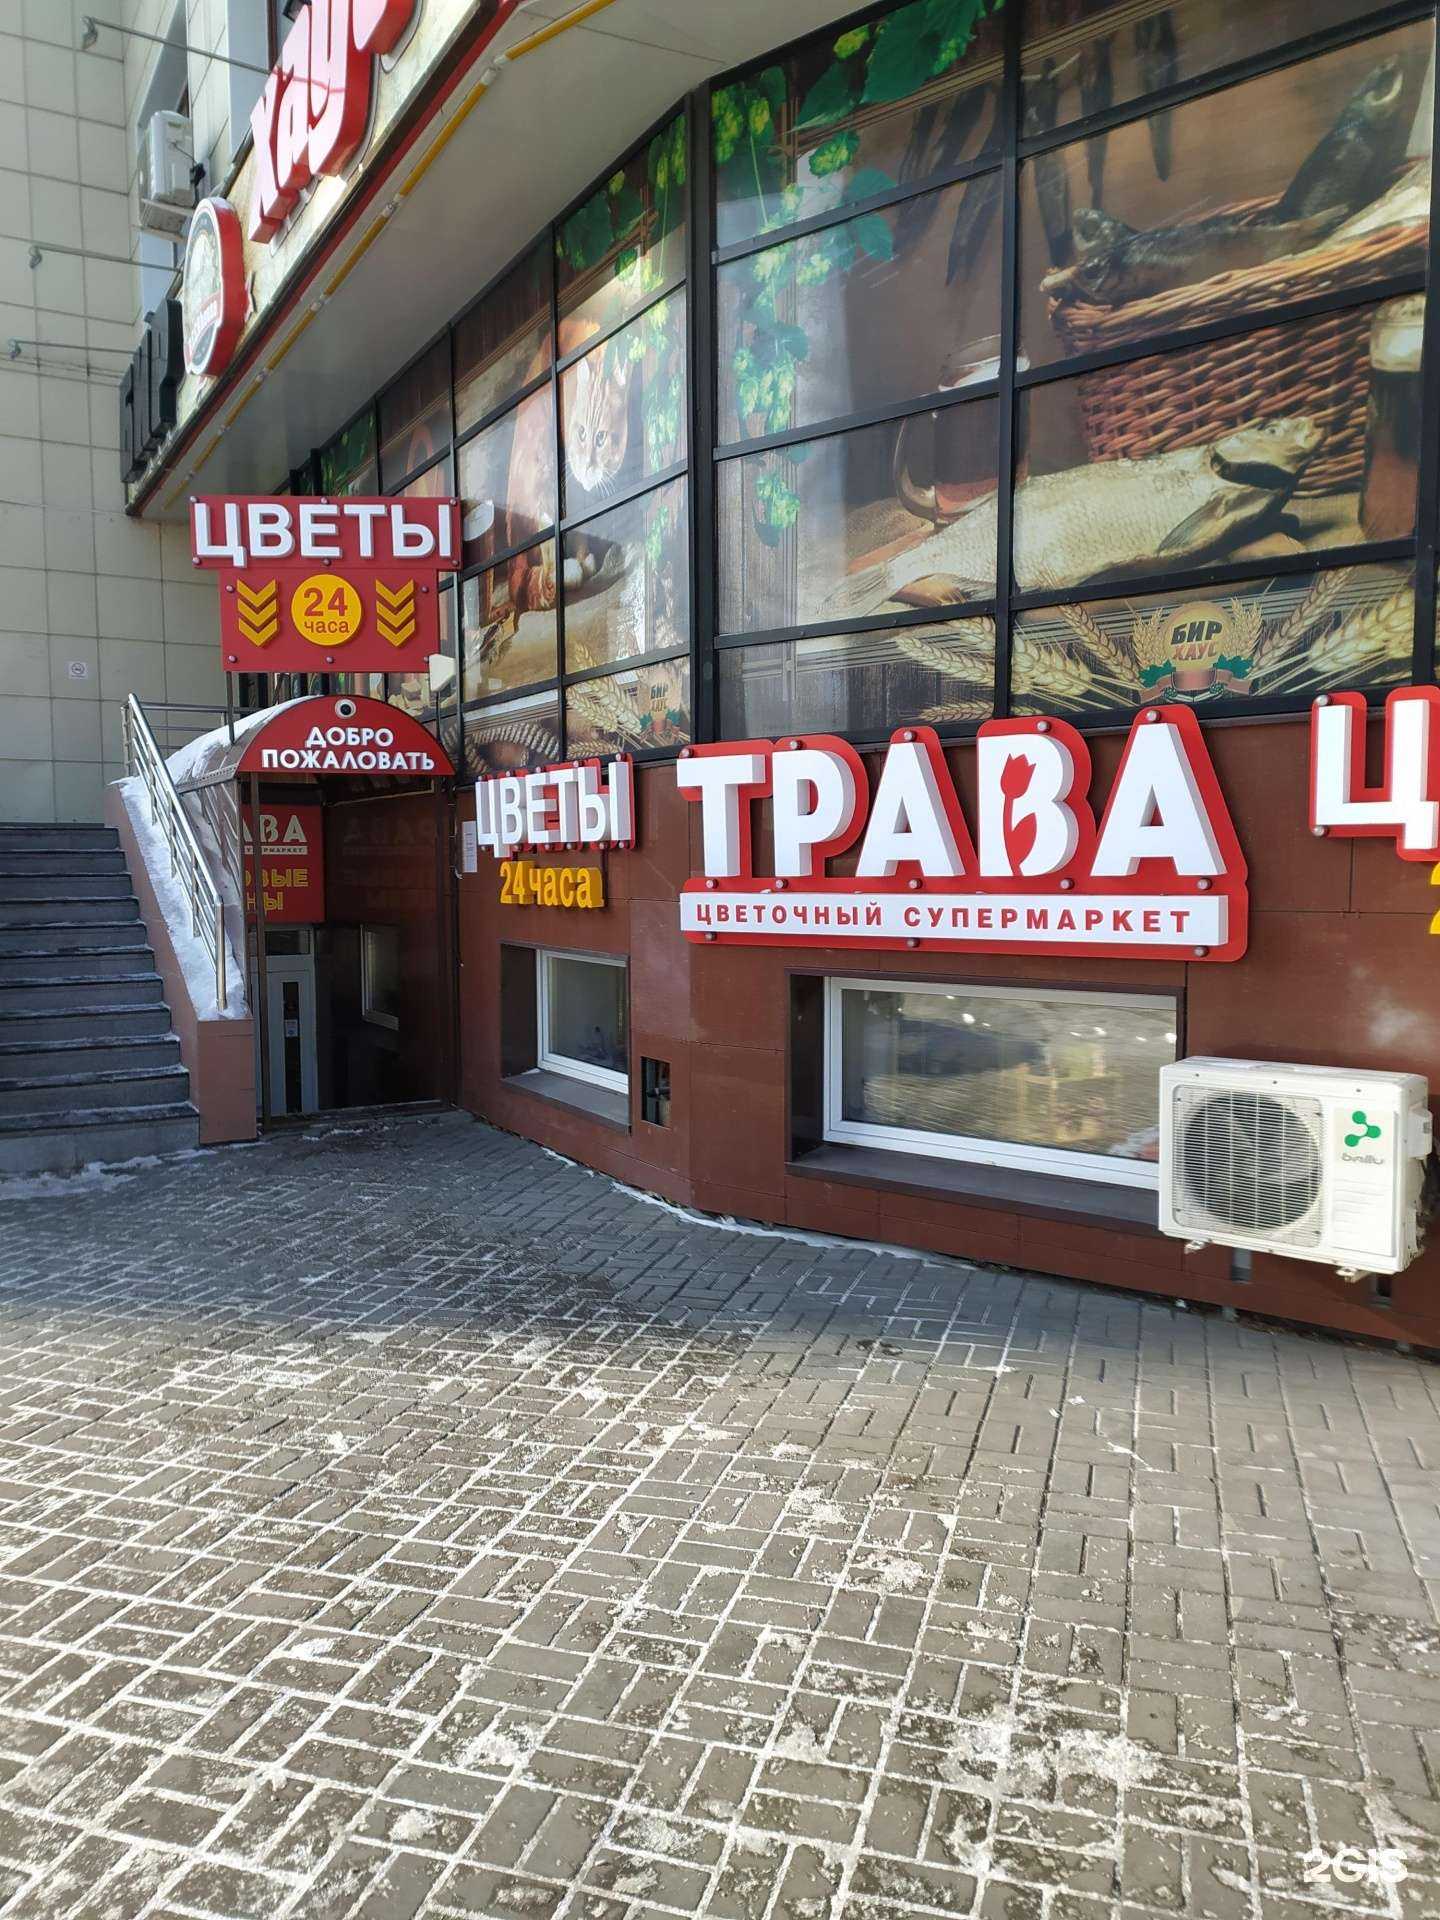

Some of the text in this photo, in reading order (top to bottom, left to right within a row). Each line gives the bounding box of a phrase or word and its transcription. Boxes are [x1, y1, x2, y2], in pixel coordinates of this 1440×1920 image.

[194, 503, 452, 568] ЦВЕТЫ
[303, 587, 348, 617] 24
[304, 619, 350, 634] часа
[1171, 620, 1223, 645] БИР
[304, 726, 395, 748] ДОБРО
[261, 749, 435, 770] ПОЖАЛОВАТЬ
[475, 762, 632, 859] ЦВЕТЫ
[677, 722, 1228, 877] ТРАВА
[500, 861, 603, 908] 24 часа
[696, 902, 1190, 933] ЦВЕТОЧНЫЙ СУПЕРМАРКЕТ
